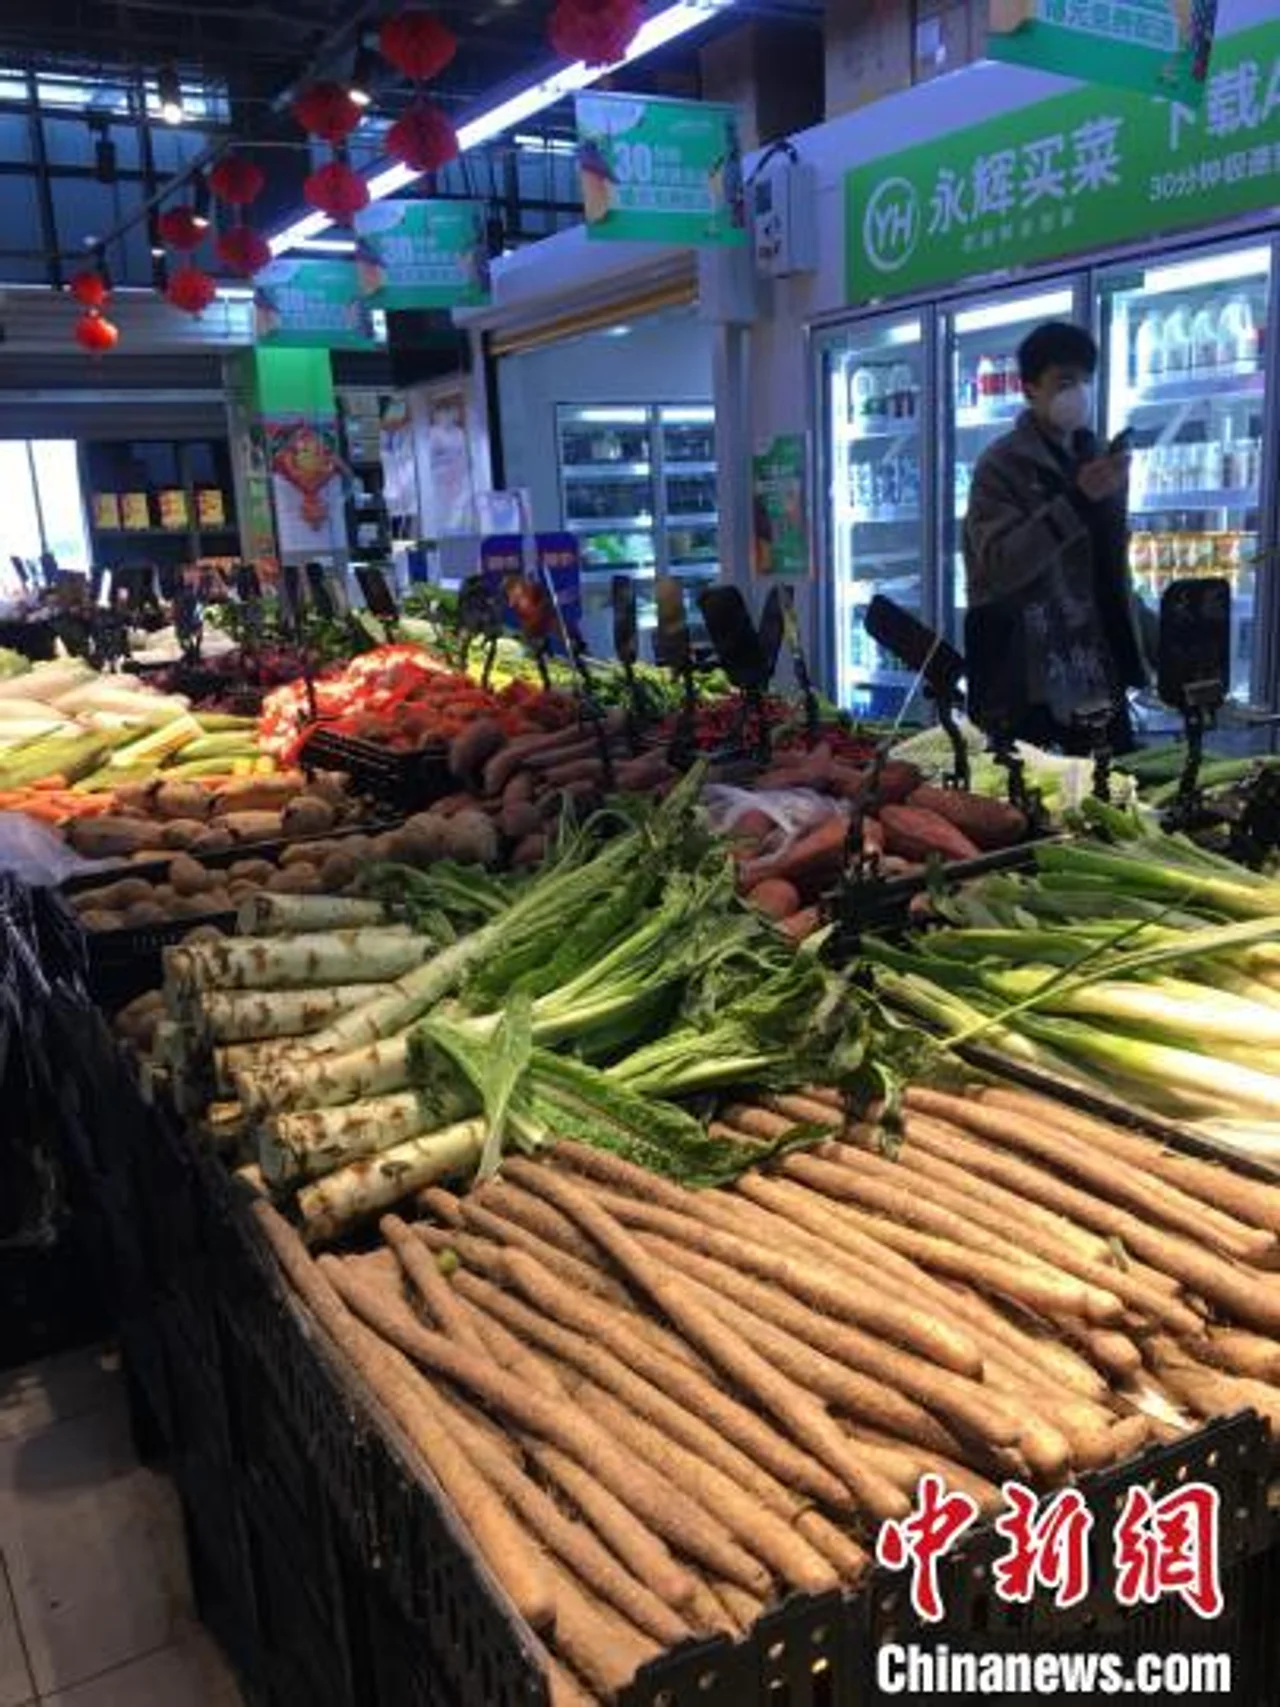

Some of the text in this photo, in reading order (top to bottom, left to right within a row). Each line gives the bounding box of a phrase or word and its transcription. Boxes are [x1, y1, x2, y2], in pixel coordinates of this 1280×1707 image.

[613, 143, 652, 182] 30
[927, 116, 1124, 235] 永辉买菜
[875, 202, 914, 254] YH
